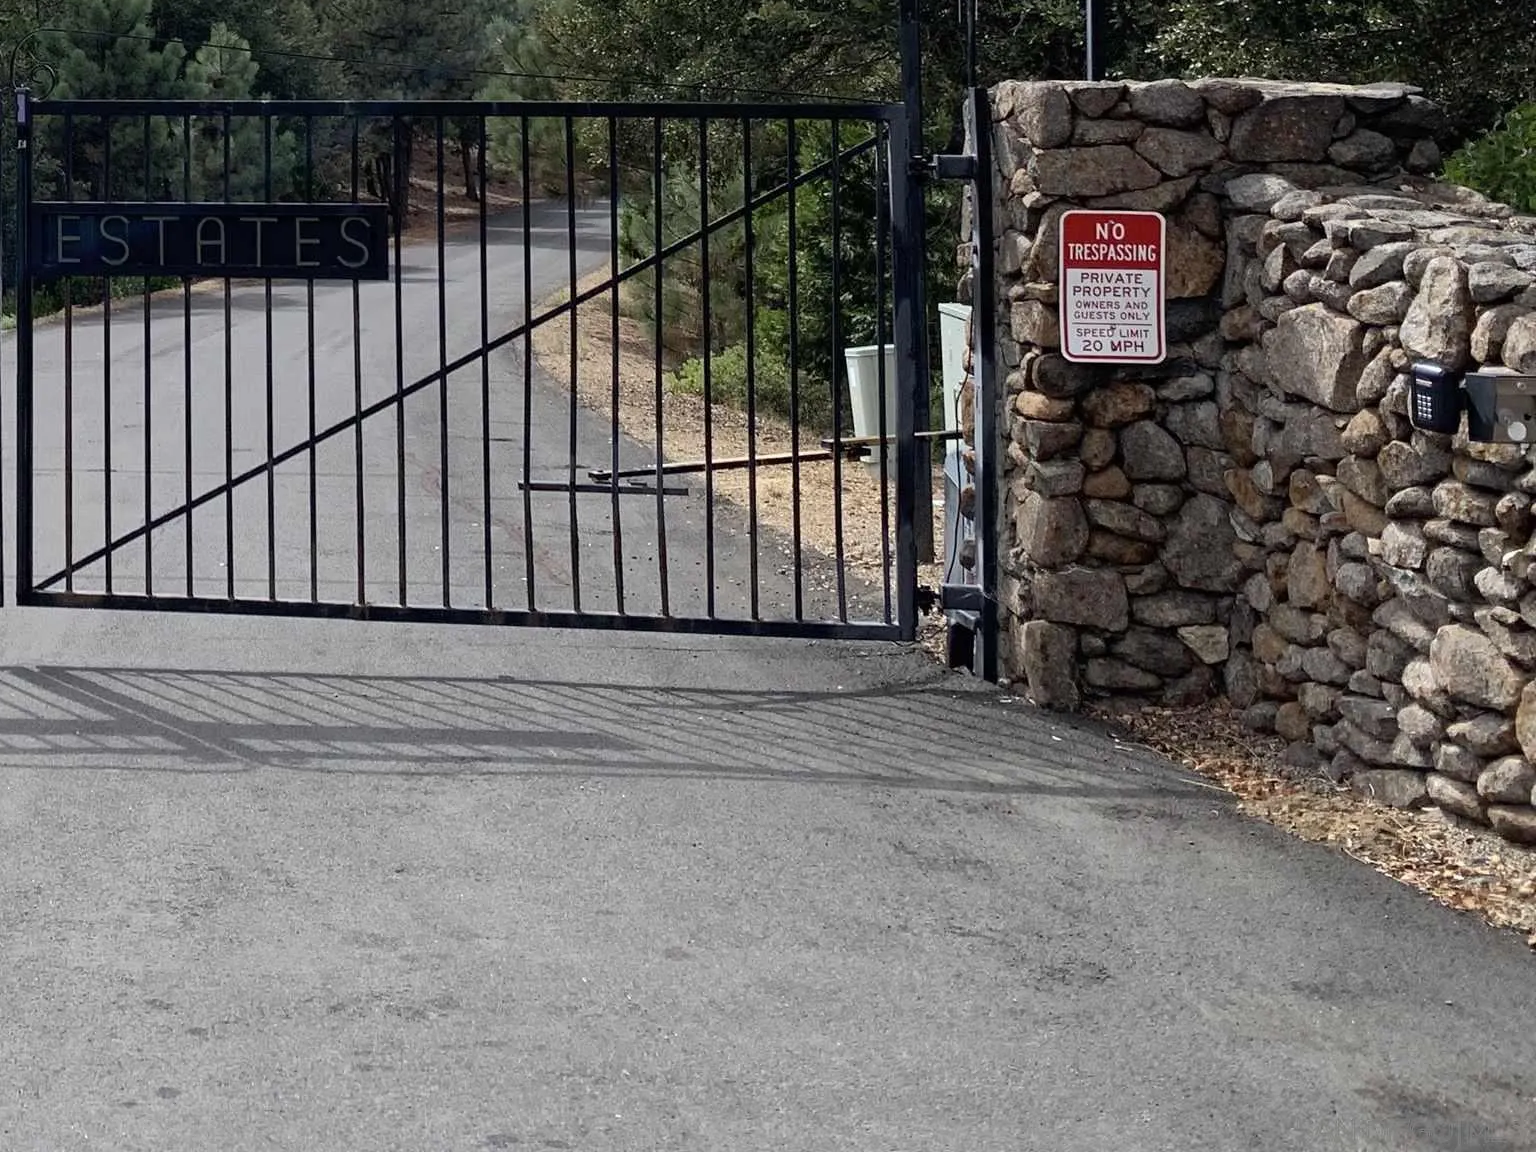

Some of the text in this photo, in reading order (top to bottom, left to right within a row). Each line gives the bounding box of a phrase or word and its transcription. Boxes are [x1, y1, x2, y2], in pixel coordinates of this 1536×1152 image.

[1096, 223, 1125, 240] NO
[57, 215, 371, 268] ESTATES
[1068, 244, 1156, 261] TRESPASSING
[1081, 273, 1143, 284] PRIVATE
[1073, 286, 1151, 297] PROPERTY
[1076, 301, 1121, 309] OWNERS
[1074, 312, 1150, 320] GUESTS ONLY
[1076, 329, 1149, 338] SPEED LIMIT
[1082, 340, 1144, 352] 20 MPH
